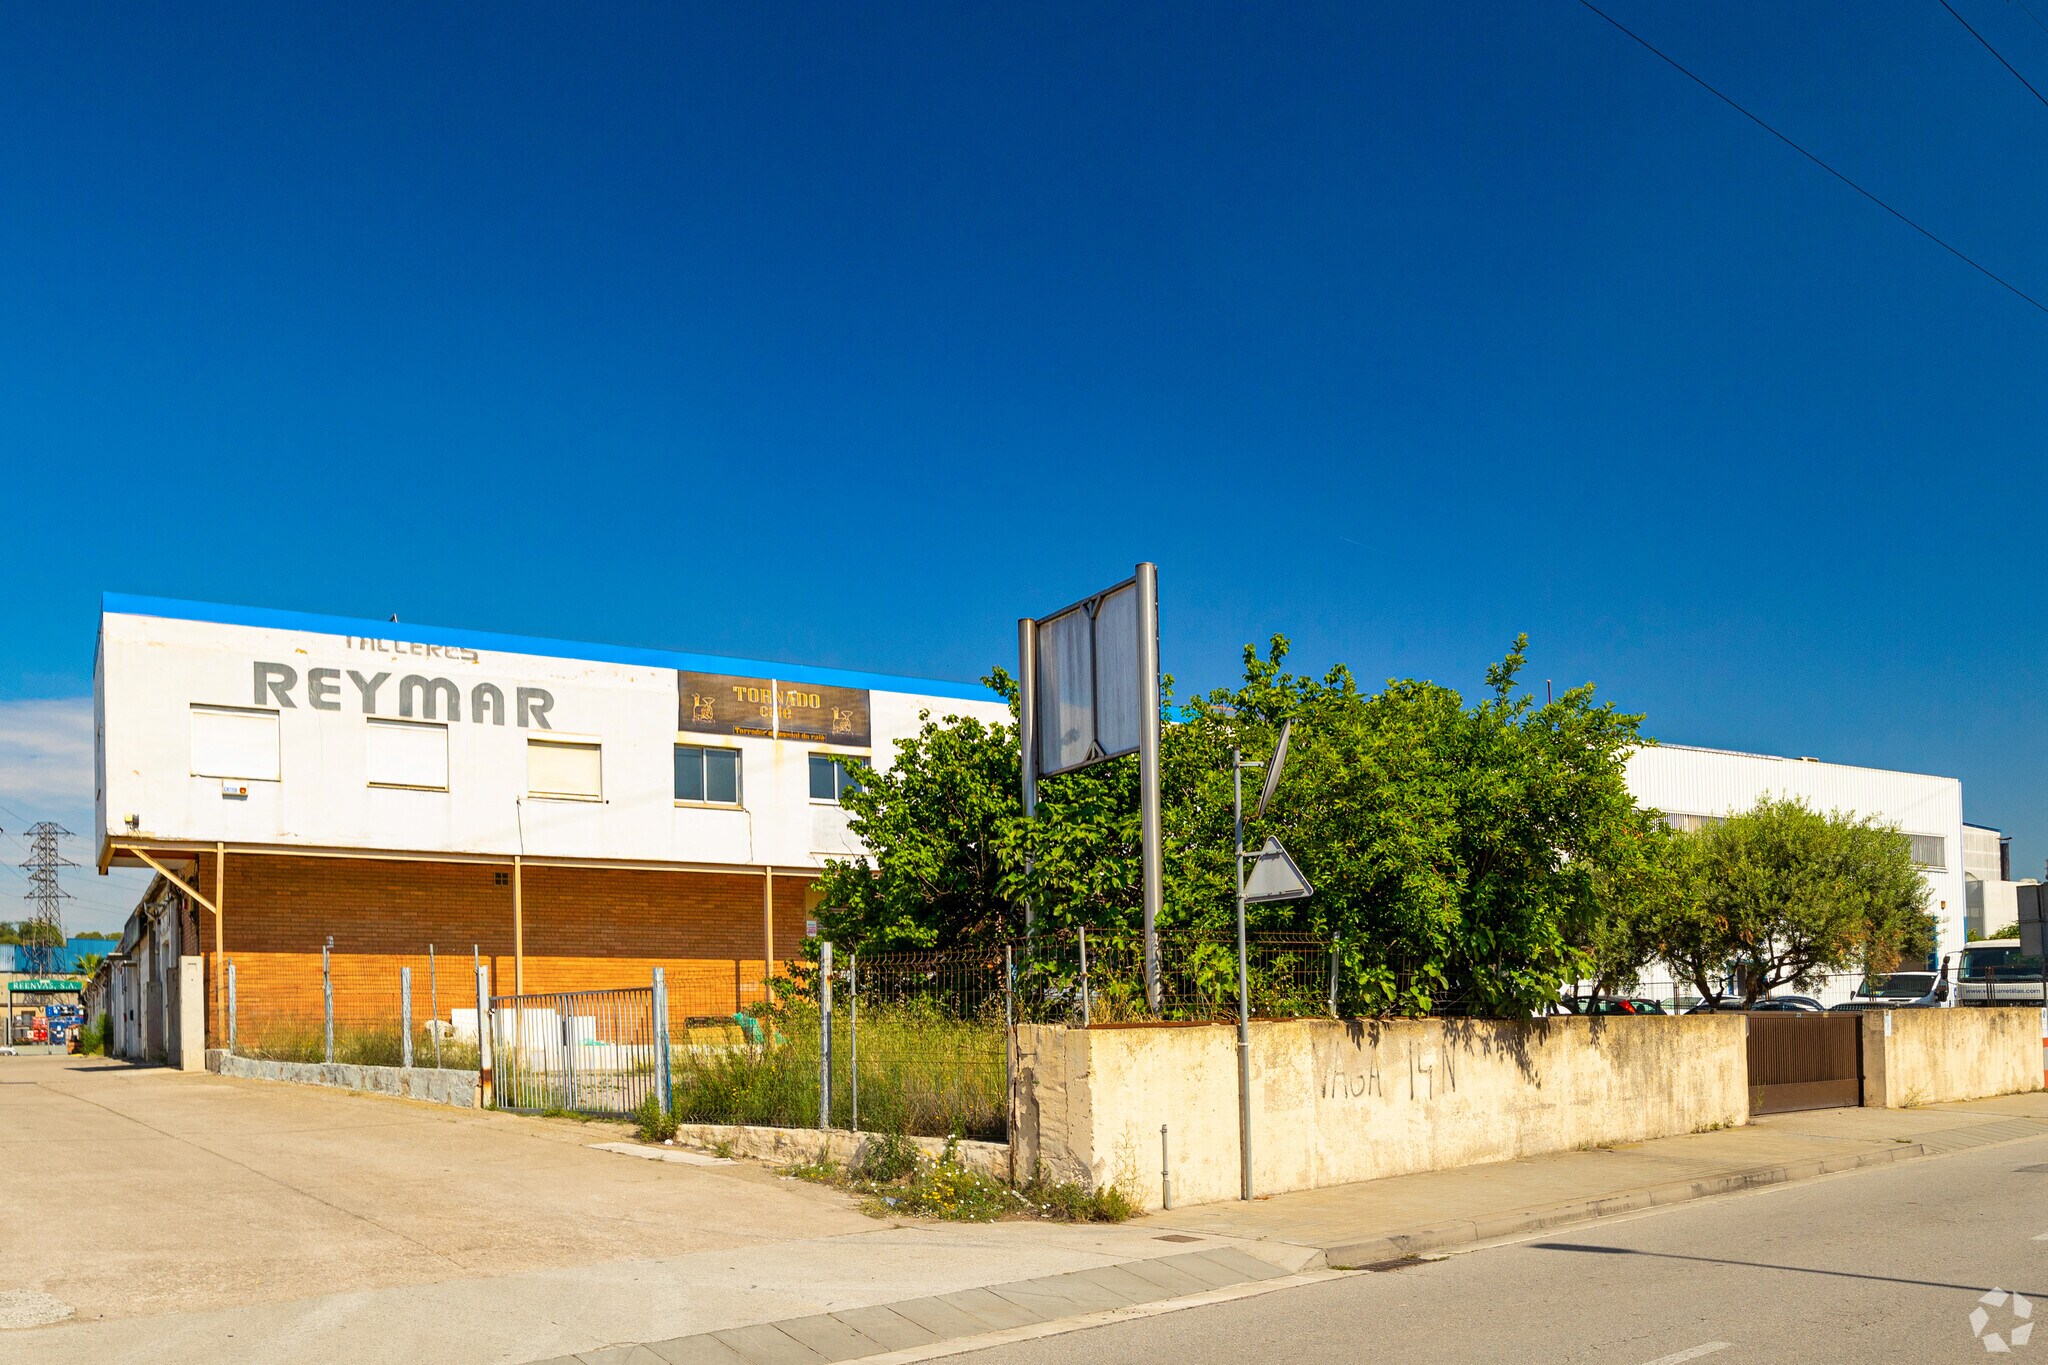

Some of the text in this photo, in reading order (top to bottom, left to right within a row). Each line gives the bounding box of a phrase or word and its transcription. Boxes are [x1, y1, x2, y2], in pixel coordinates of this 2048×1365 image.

[253, 661, 555, 729] REYMAR
[732, 685, 821, 709] TORNADO
[60, 982, 77, 990] S.A.
